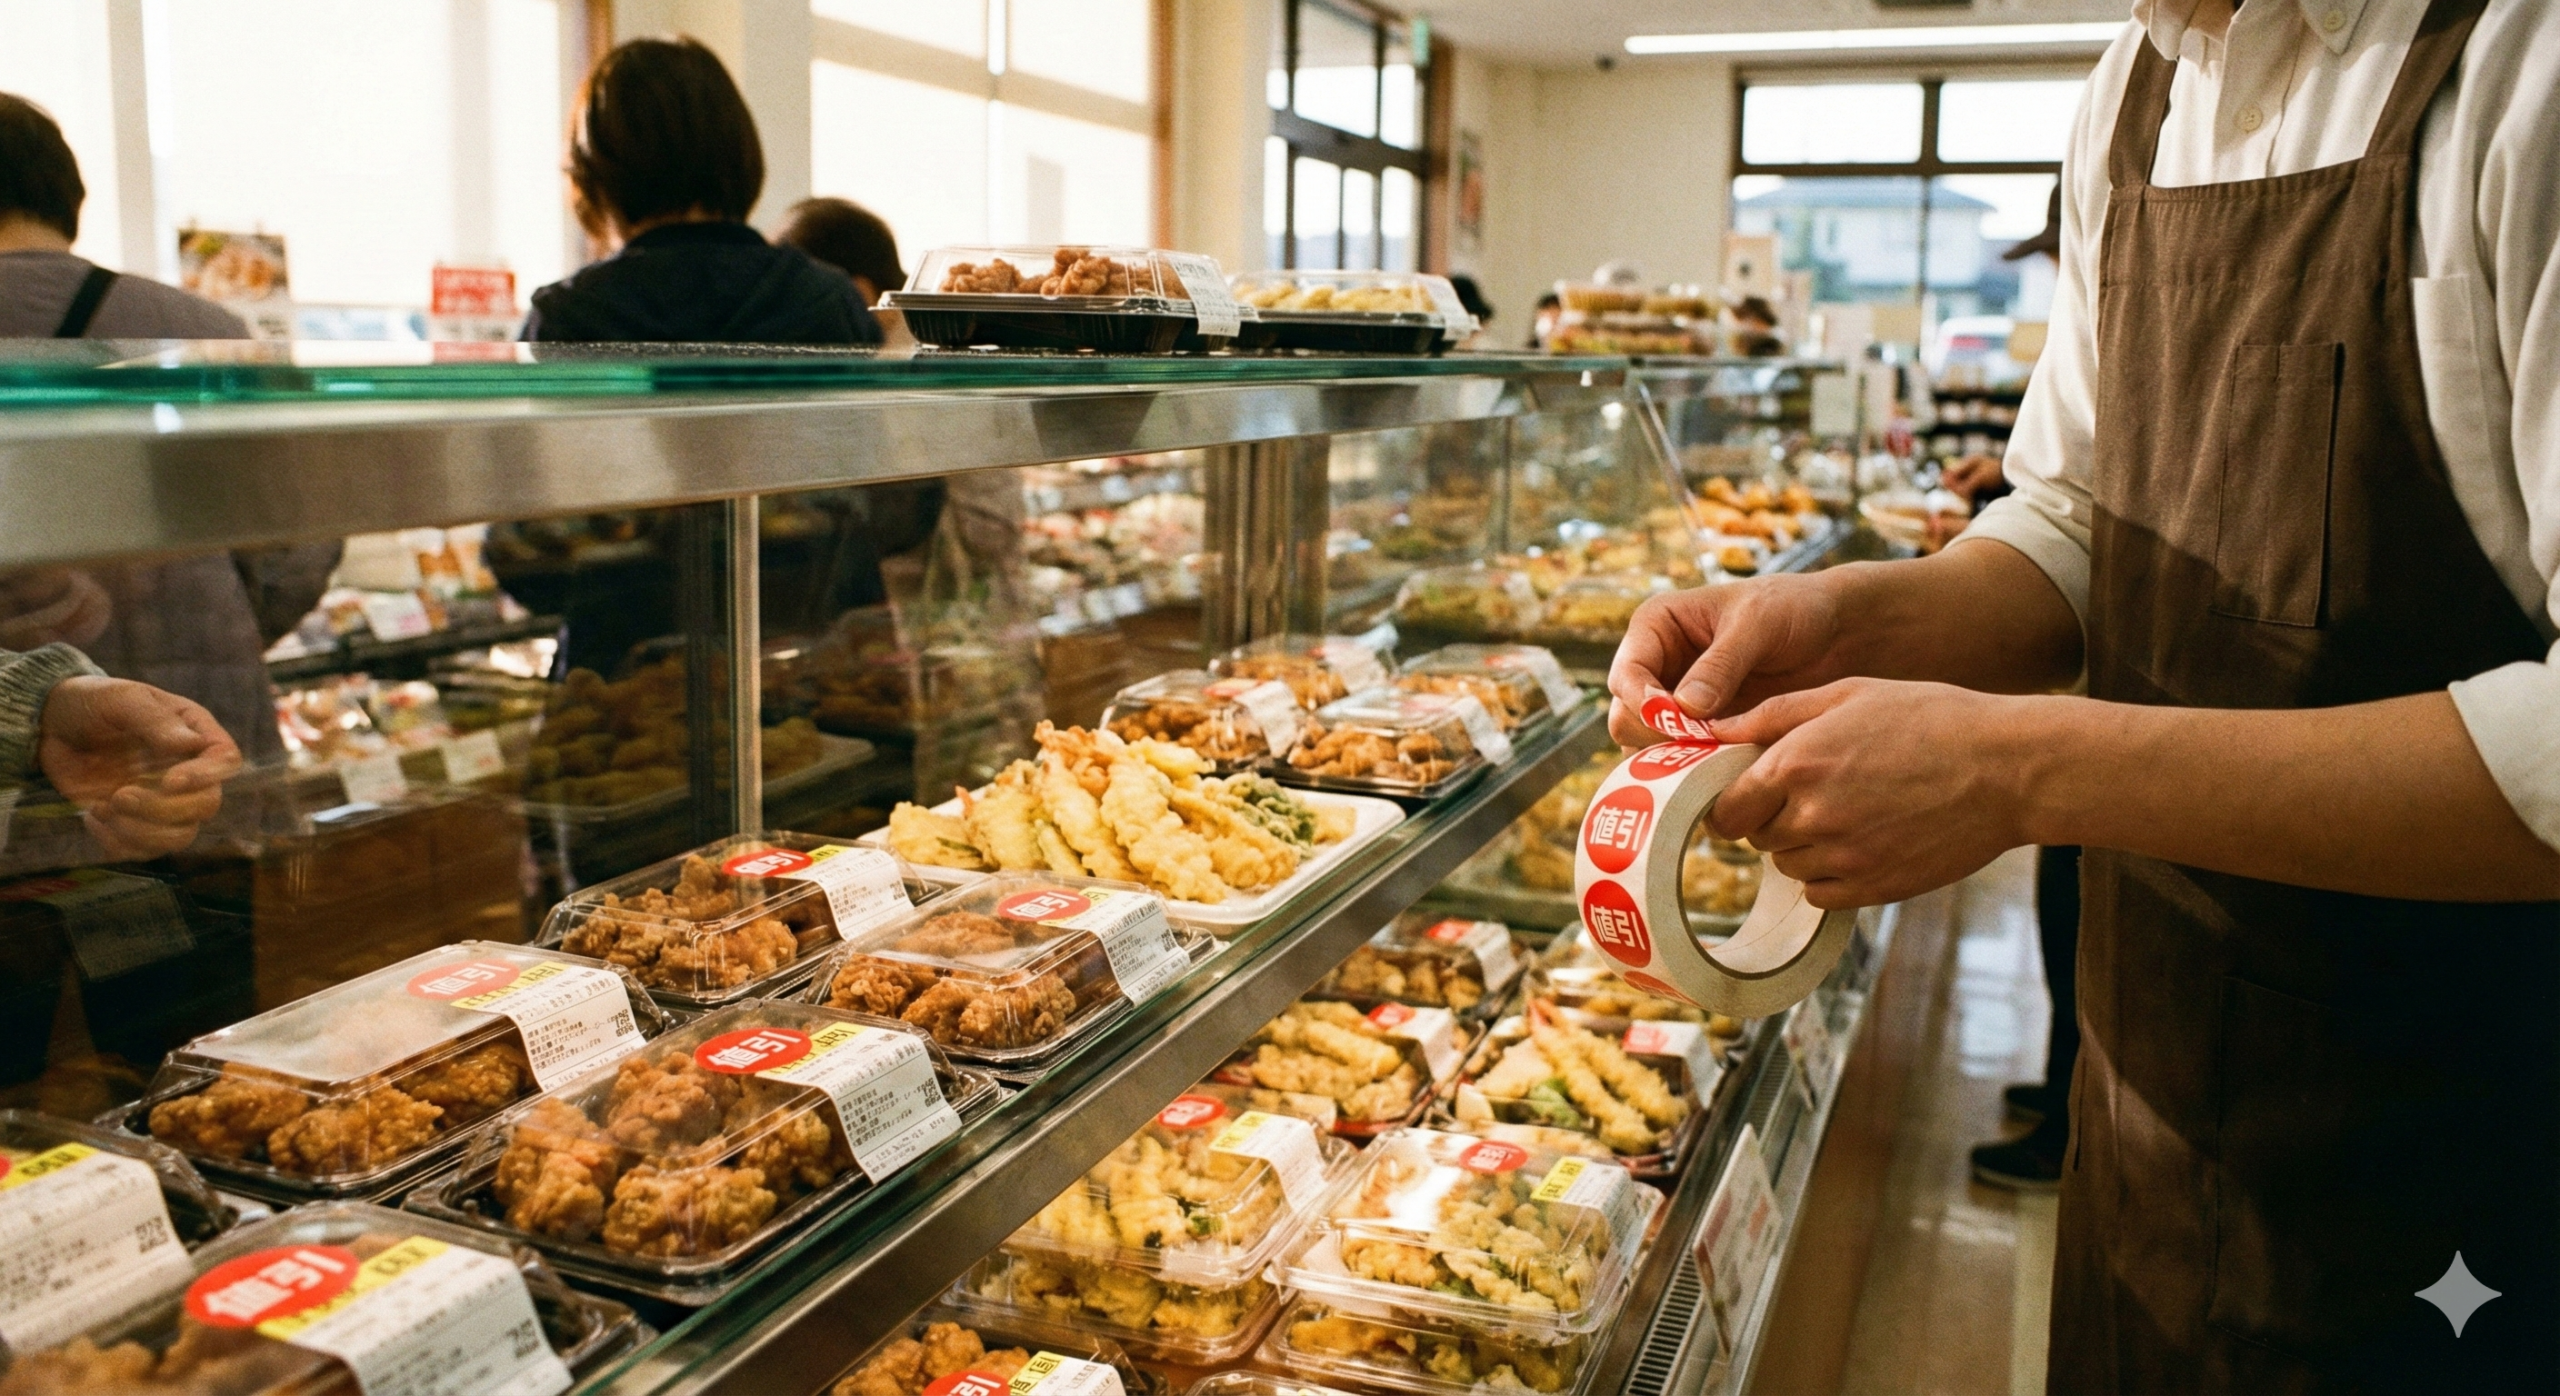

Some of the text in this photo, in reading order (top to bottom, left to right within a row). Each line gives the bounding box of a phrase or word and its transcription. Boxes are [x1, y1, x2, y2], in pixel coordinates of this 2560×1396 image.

[1589, 804, 1648, 852] 値引
[1590, 903, 1646, 950] 値引
[706, 1030, 802, 1069] 値引
